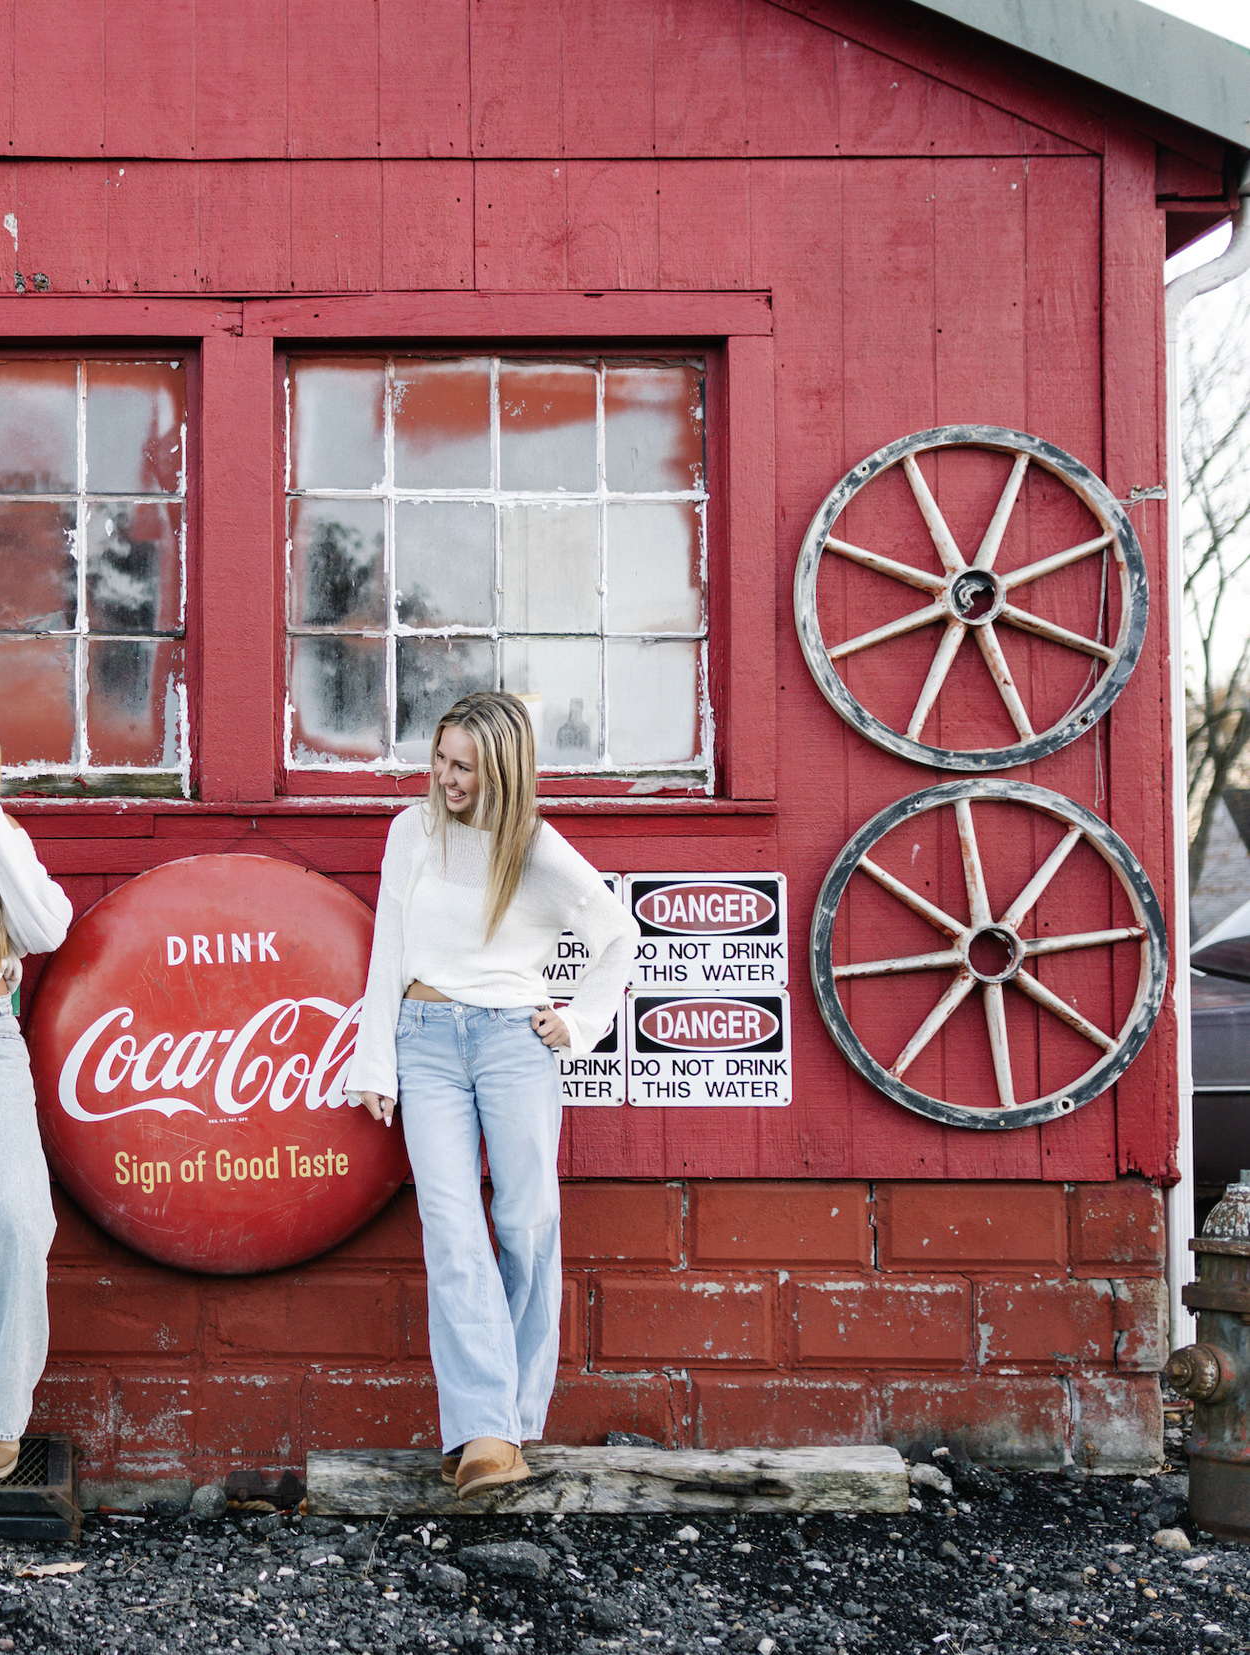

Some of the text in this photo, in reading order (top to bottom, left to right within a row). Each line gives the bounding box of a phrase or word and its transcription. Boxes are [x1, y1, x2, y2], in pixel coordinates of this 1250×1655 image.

[653, 893, 758, 923] DANGER
[166, 931, 280, 966] DRINK
[558, 942, 592, 958] DRI
[669, 943, 711, 960] NOT
[722, 942, 785, 959] DRINK
[542, 963, 586, 980] WAT
[639, 964, 775, 982] THIS WATER
[656, 1009, 761, 1040] DANGER
[560, 1059, 622, 1076] DRINK
[631, 1058, 788, 1077] DO NOT DRINK
[562, 1081, 612, 1098] ATER
[642, 1081, 778, 1098] THIS WATER
[115, 1145, 349, 1194] Sign of Good Taste
